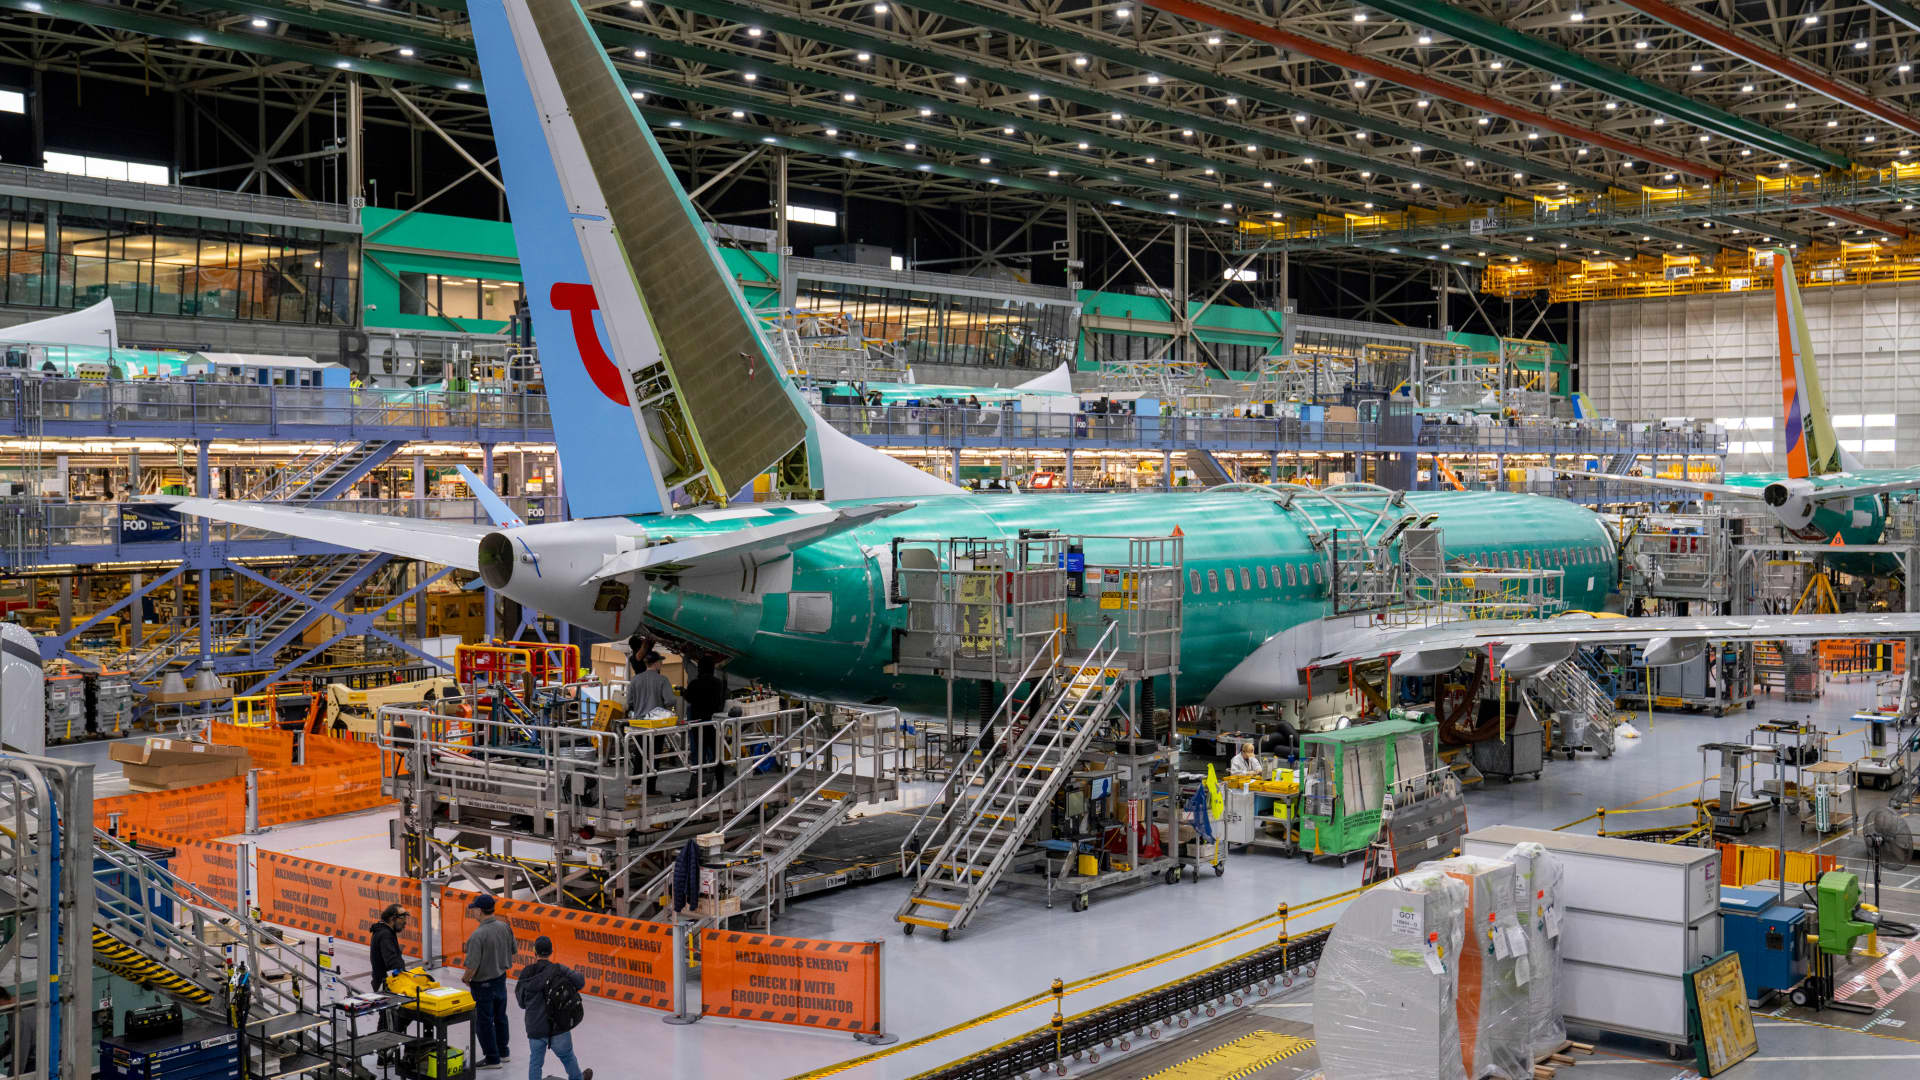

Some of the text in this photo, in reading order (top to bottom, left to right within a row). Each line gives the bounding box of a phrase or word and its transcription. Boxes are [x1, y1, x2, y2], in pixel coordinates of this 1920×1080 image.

[528, 508, 544, 517] FOD
[123, 520, 147, 531] FOD
[275, 867, 332, 890] HAZARDOUS ENERGY
[281, 888, 301, 902] CHECK
[310, 895, 329, 908] WITH
[511, 917, 541, 933] ENERGY
[574, 928, 662, 953] HAZARDOUS ENERGY
[587, 951, 653, 974] CHECK IN WITH
[735, 950, 849, 973] HAZARDOUS ENERGY
[574, 964, 666, 993] GROUP COORDINATOR
[749, 974, 835, 995] CHECK IN WITH
[731, 989, 854, 1014] GROUP COORDINATOR
